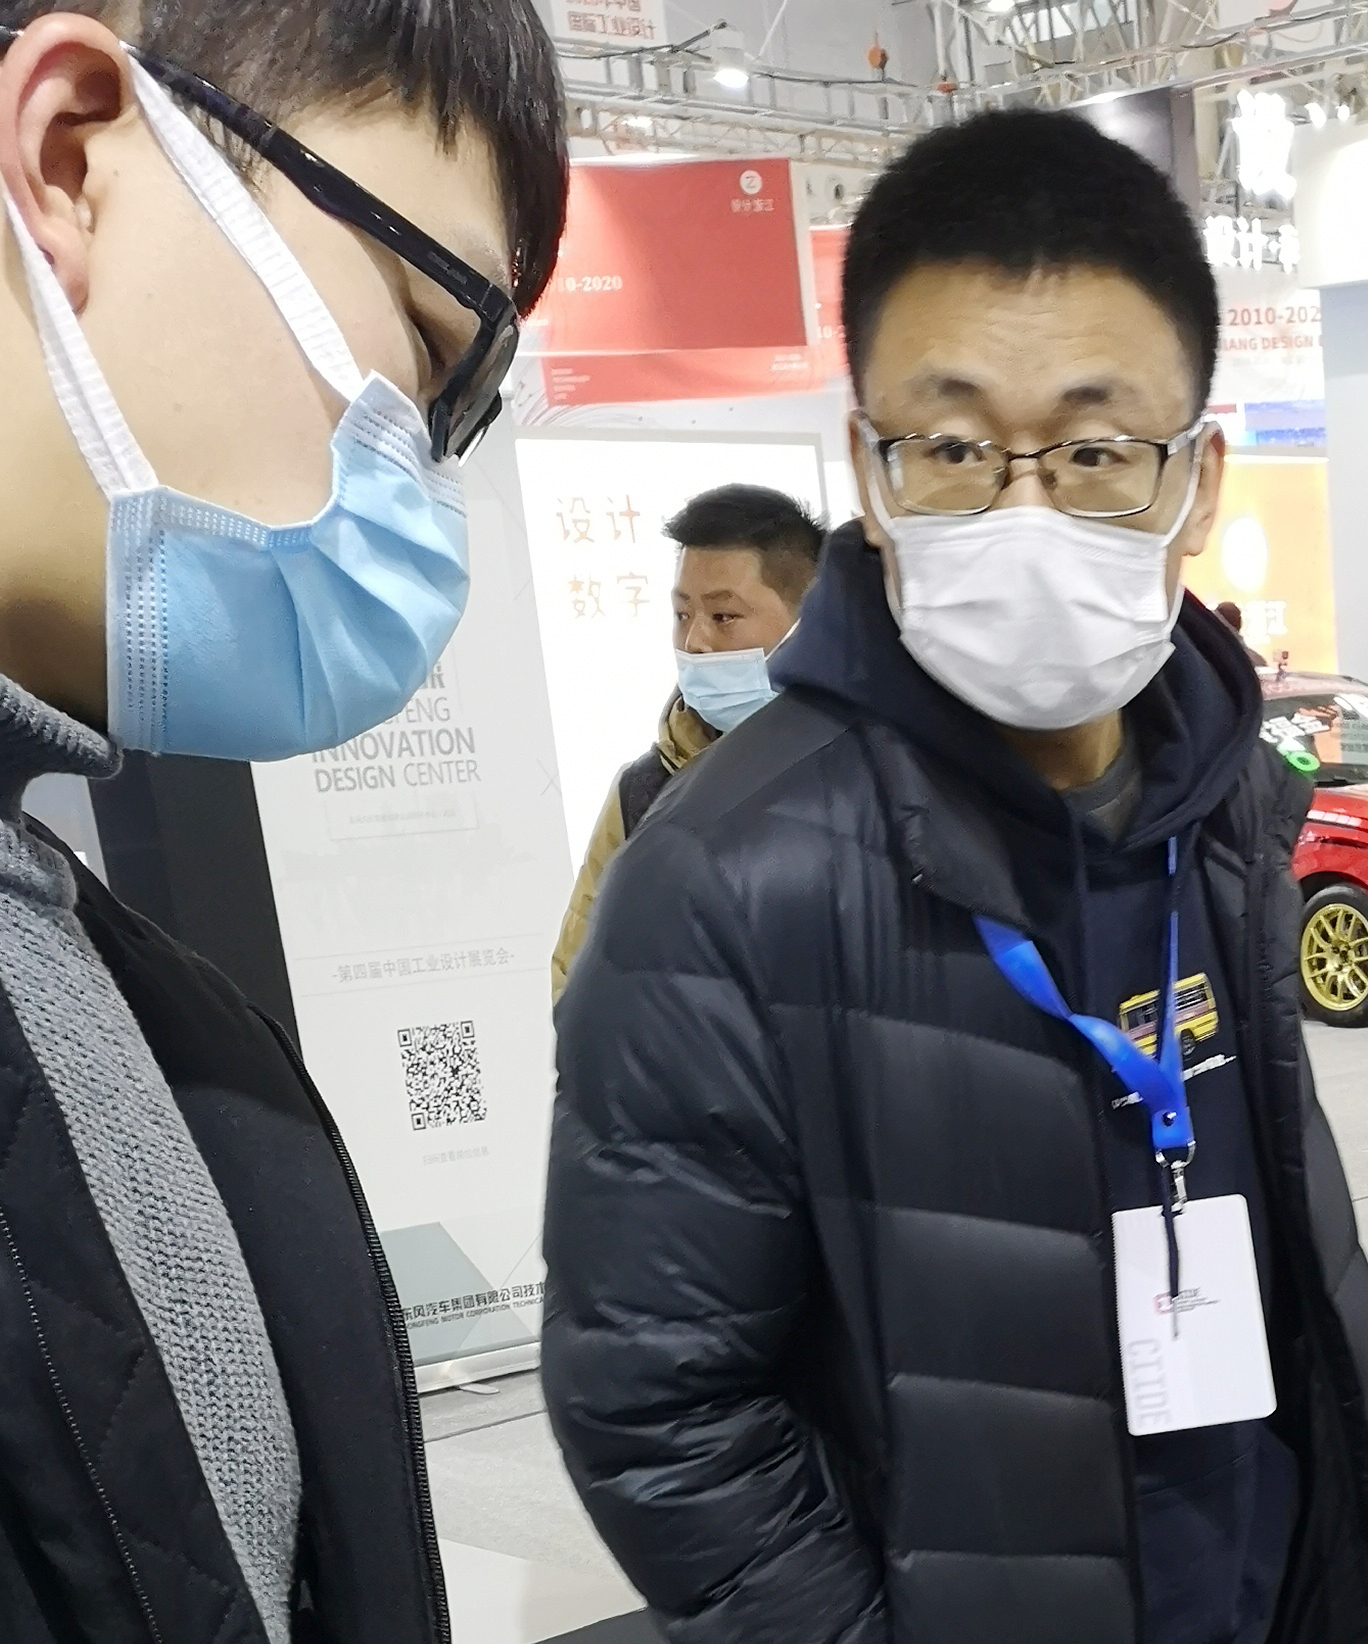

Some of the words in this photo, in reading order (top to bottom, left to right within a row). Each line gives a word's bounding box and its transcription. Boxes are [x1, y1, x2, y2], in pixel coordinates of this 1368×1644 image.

[1261, 335, 1314, 350] DESIGN
[556, 494, 640, 543] 设计
[568, 571, 651, 619] 数字
[315, 765, 396, 793] DESIGN
[403, 759, 482, 787] CENTER
